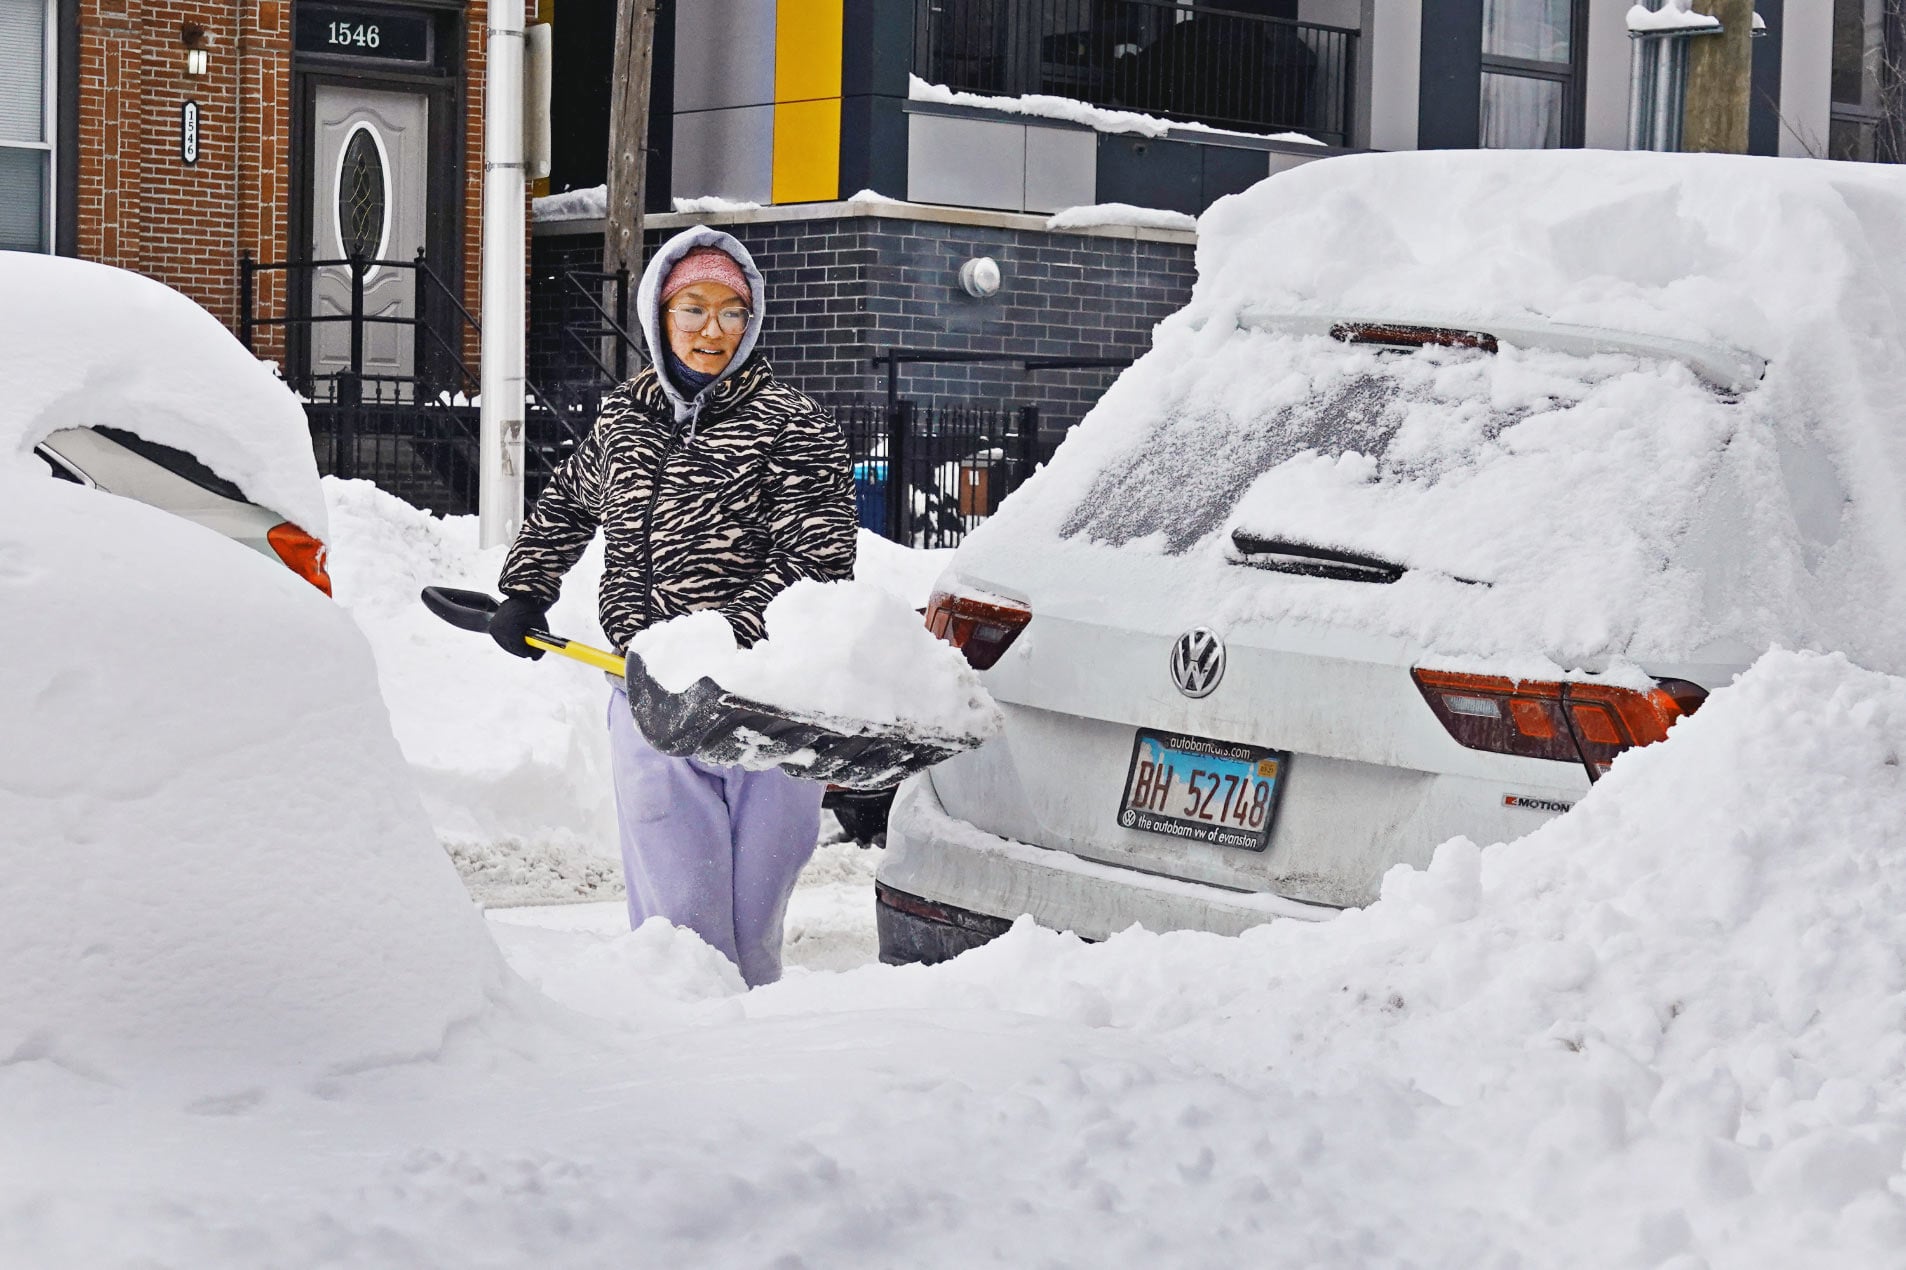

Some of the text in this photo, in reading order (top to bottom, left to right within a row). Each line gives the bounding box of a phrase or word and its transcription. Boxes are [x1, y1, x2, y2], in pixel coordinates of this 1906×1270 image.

[328, 22, 380, 48] 1546
[186, 110, 195, 155] 1546
[1170, 626, 1227, 699] VW
[1131, 761, 1270, 828] BH 52748
[1138, 815, 1152, 830] the
[1153, 819, 1192, 837] autobarn
[1194, 827, 1208, 839] vw
[1208, 828, 1218, 842] of
[1218, 832, 1257, 848] evanston
